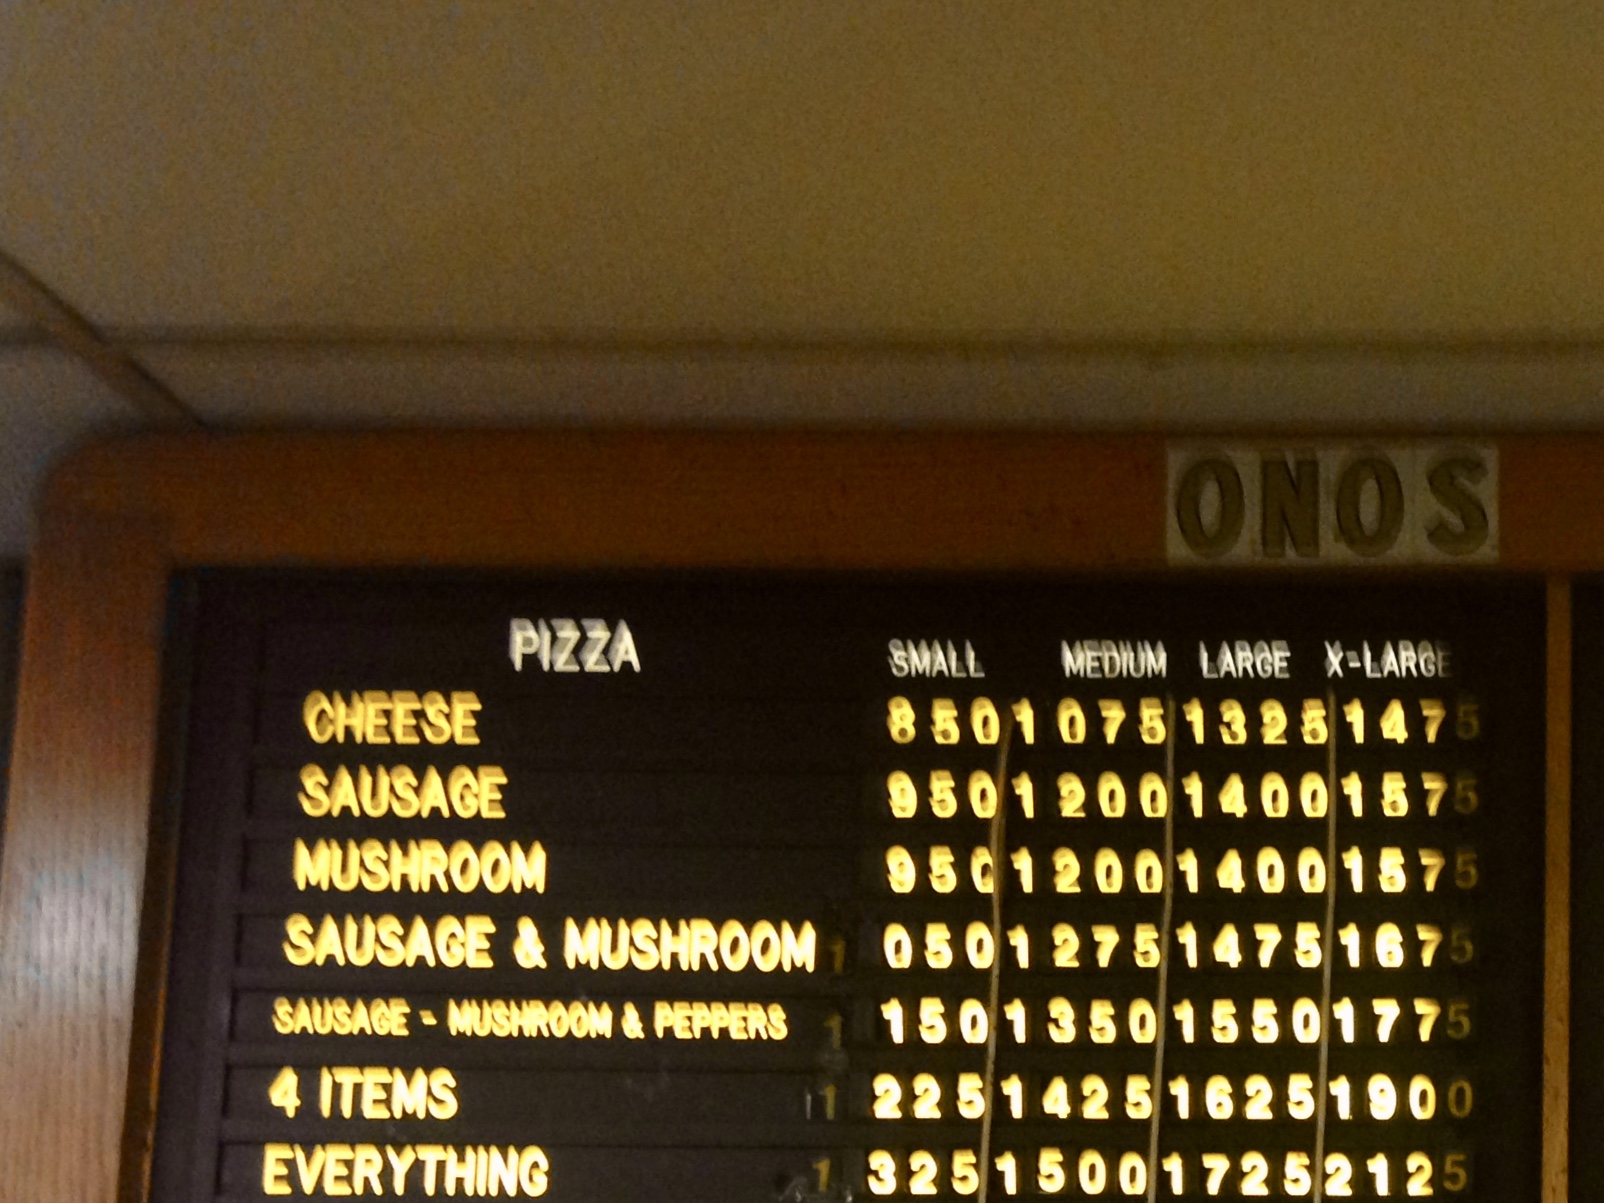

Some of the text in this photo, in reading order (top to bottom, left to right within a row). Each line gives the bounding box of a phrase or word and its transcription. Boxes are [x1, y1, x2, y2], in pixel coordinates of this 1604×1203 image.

[1175, 452, 1490, 558] ONOS
[510, 618, 640, 672] PIZZA
[889, 639, 985, 678] SMALL
[1061, 639, 1167, 678] MEDIUM
[1200, 639, 1290, 678] LARGE
[1325, 639, 1452, 678] X-LARGE
[303, 690, 482, 745] CHEESE
[887, 696, 1000, 744] 850
[1015, 696, 1167, 744] 1075
[1185, 697, 1329, 744] 1325
[298, 764, 508, 818] SAUSAGE
[887, 769, 998, 818] 950
[1015, 771, 1168, 818] 1200
[1184, 771, 1329, 818] 1400
[294, 838, 546, 893] MUSHROOM
[1013, 847, 1163, 893] 1200
[1177, 847, 1326, 893] 1400
[283, 914, 497, 969] SAUSAGE
[512, 917, 546, 969] &
[564, 917, 816, 973] MUSHROOM
[1008, 922, 1162, 969] 1275
[1177, 921, 1322, 969] 1475
[272, 997, 410, 1036] SAUSAGE
[447, 999, 612, 1038] MUSHROOM
[621, 1001, 645, 1038] &
[654, 1002, 789, 1040] PEPPERS
[1006, 997, 1157, 1043] 1350
[1173, 998, 1321, 1043] 1550
[267, 1066, 300, 1119] 4
[319, 1066, 460, 1119] ITEMS
[1000, 1073, 1152, 1120] 1425
[1168, 1073, 1316, 1120] 1625
[263, 1142, 550, 1197] EVERYTHING
[995, 1150, 1147, 1196] 1500
[1162, 1151, 1311, 1195] 1725
